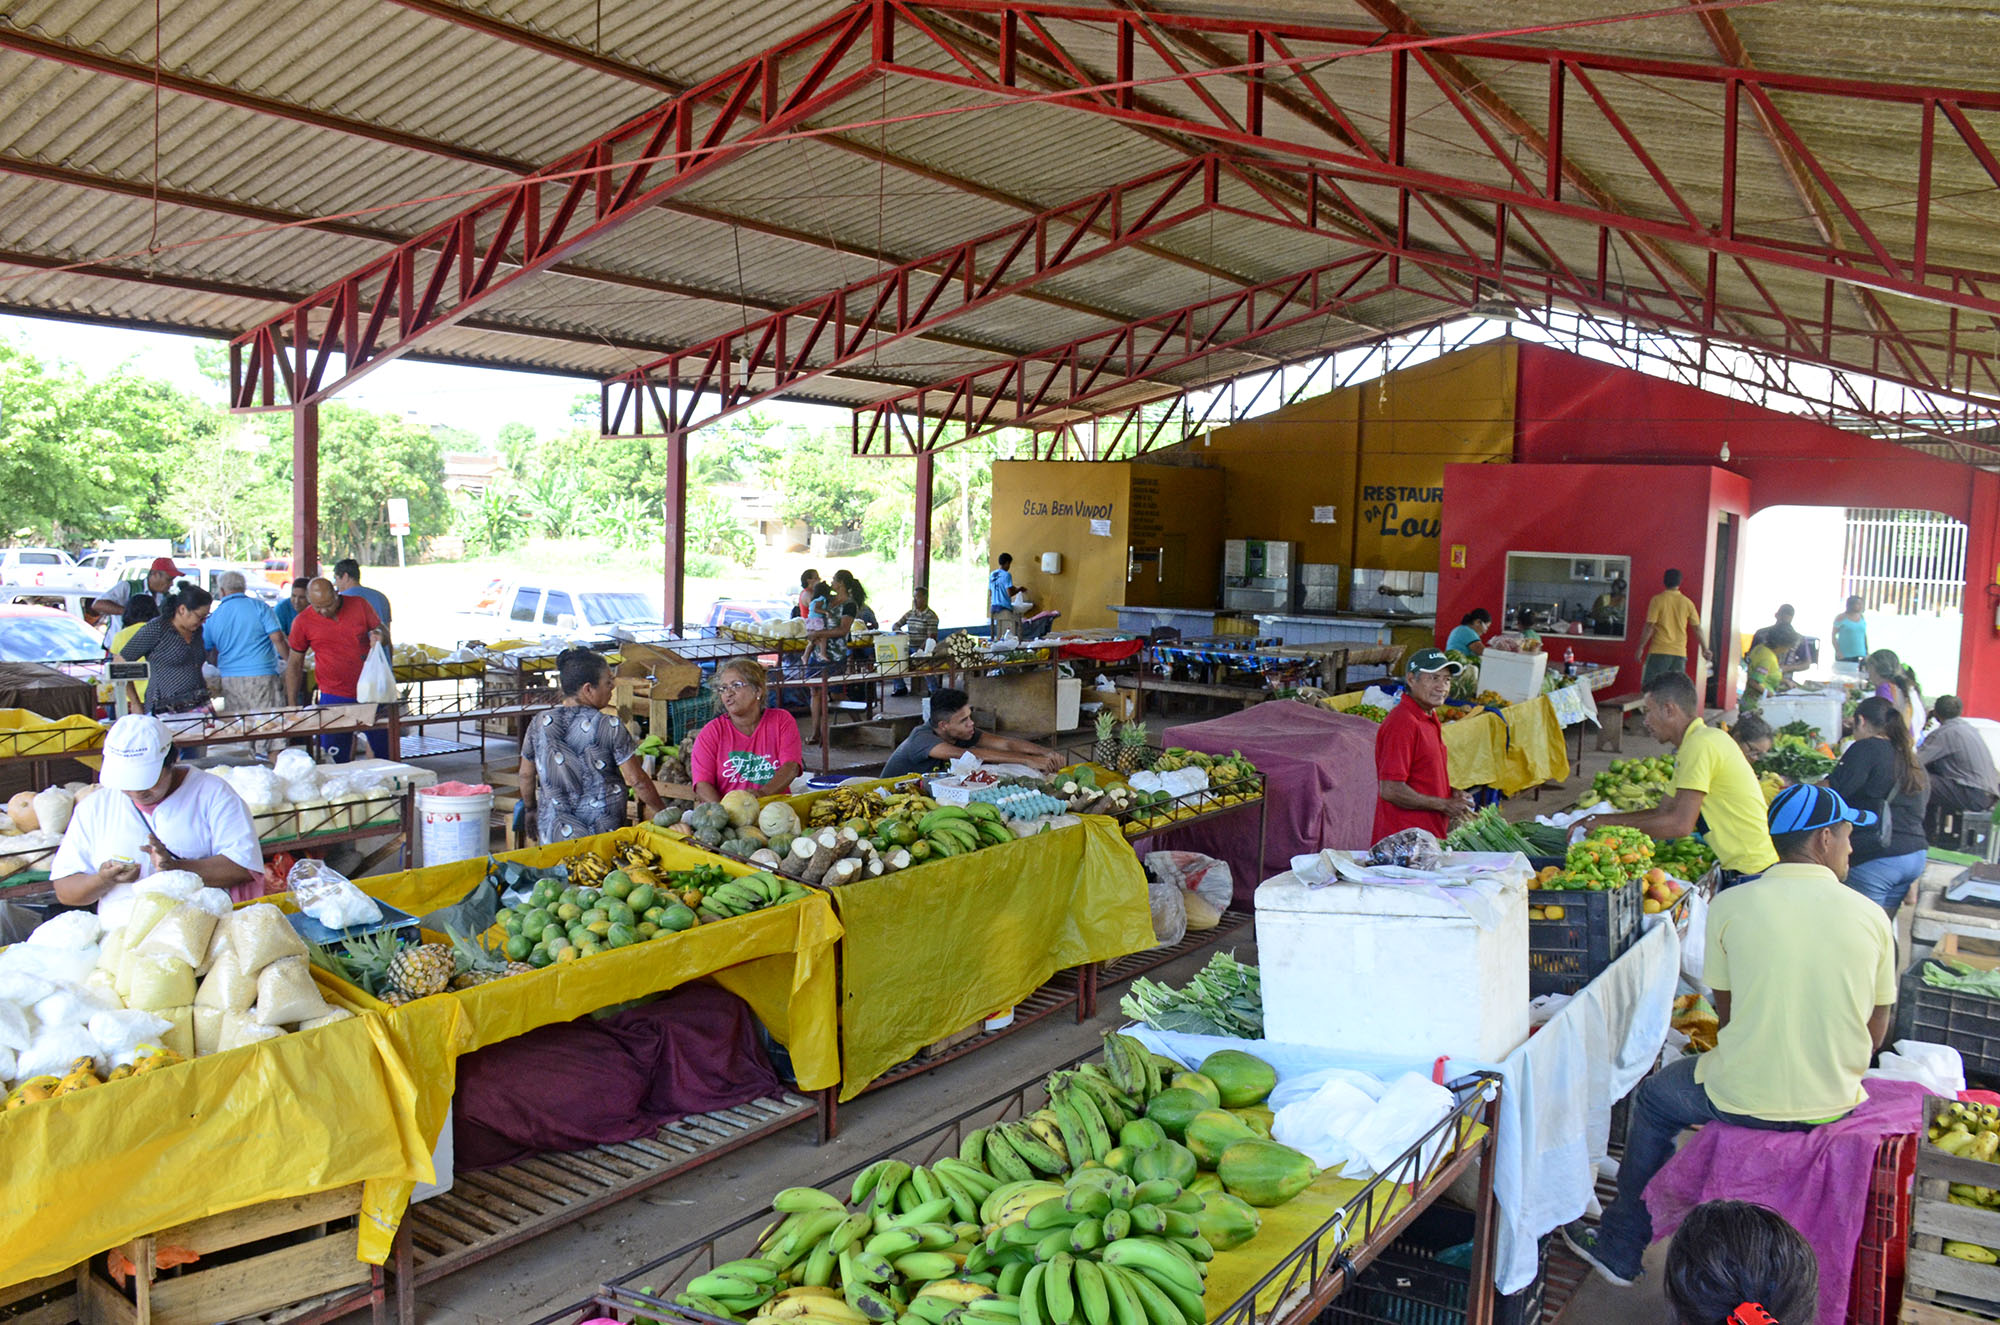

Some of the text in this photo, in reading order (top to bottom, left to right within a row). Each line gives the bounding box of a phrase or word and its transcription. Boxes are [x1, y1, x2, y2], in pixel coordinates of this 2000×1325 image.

[1023, 499, 1113, 520] SEJA BEM VINDO!
[1364, 504, 1381, 523] DA
